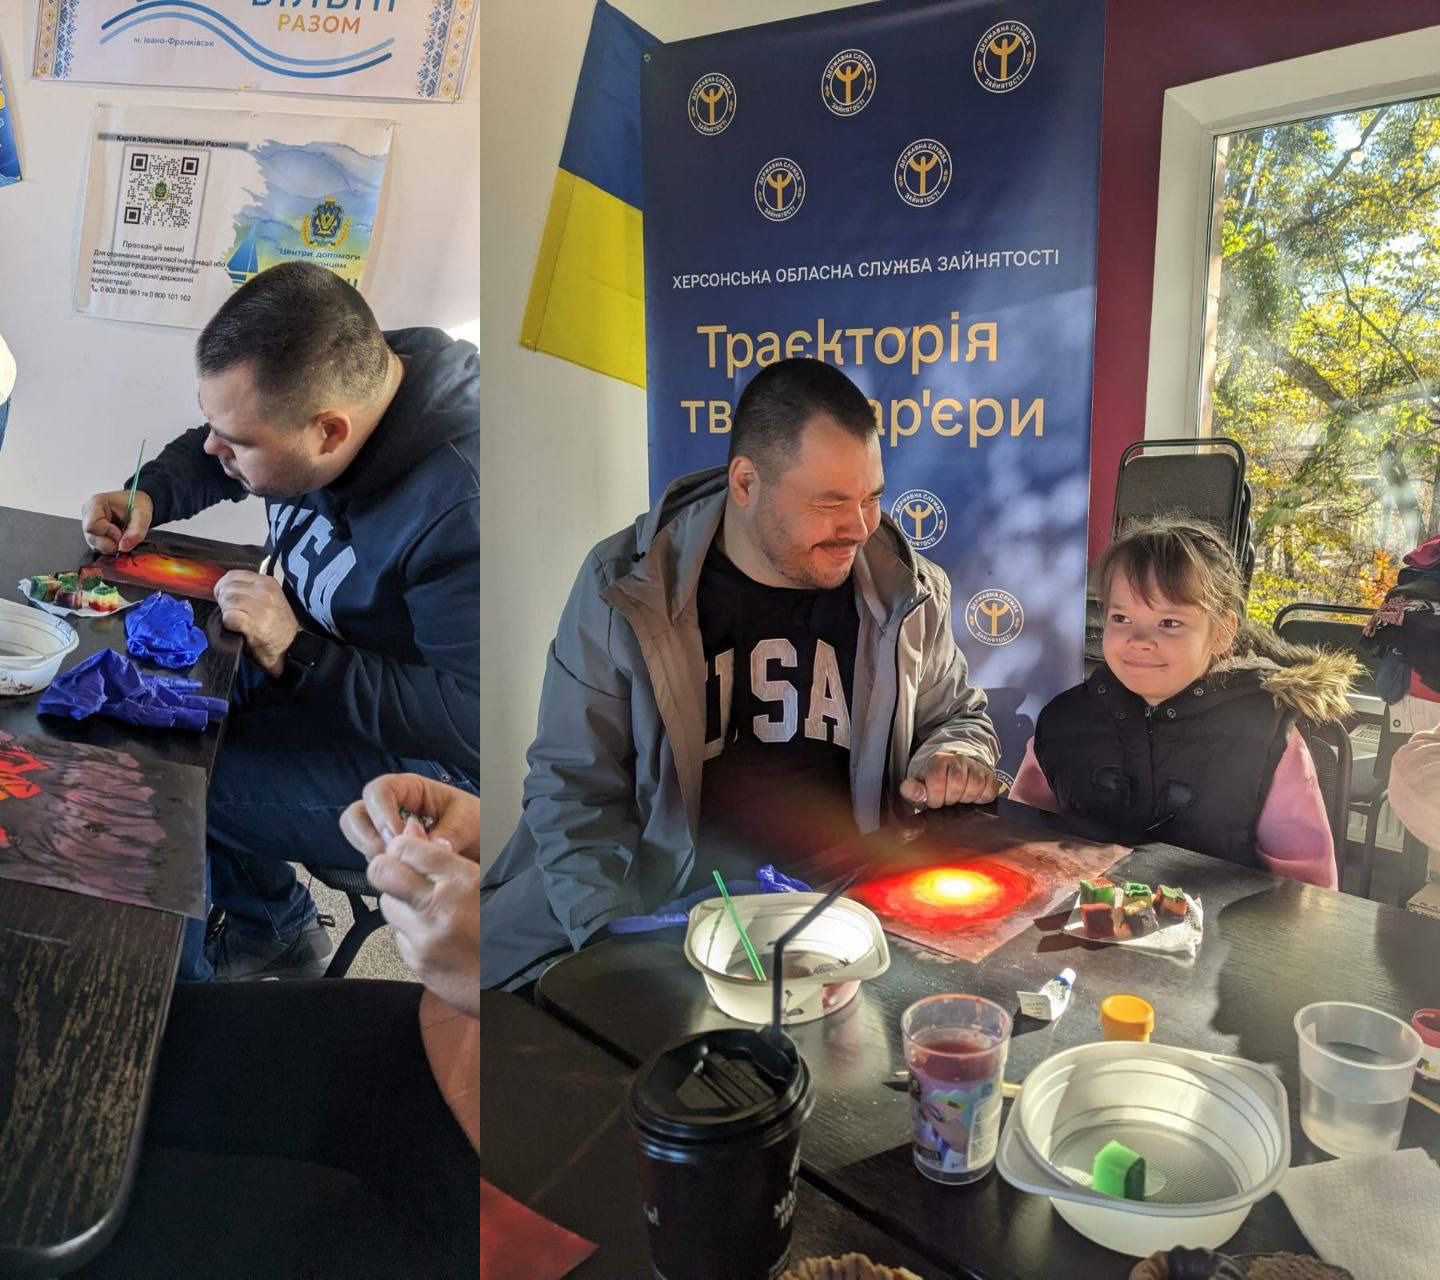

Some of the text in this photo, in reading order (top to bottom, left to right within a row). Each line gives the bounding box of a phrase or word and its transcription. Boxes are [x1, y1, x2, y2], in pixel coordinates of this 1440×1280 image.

[277, 13, 361, 34] РАЗОМ
[144, 37, 215, 47] Івано-Франківськ
[979, 24, 1031, 53] ДЕРЖАВНА СЛУЖБА
[984, 73, 1023, 90] ЗАЙНЯТОСТІ
[927, 142, 948, 164] СЛУЖБА
[280, 247, 361, 261] Центри допомоги
[673, 248, 1060, 289] ХЕРСОНСЬКА ОБЛАСНА СЛУЖБА ЗАЙНЯТОСТІ
[696, 311, 998, 379] Траєкторія
[269, 503, 357, 641] USA
[704, 638, 852, 762] USA
